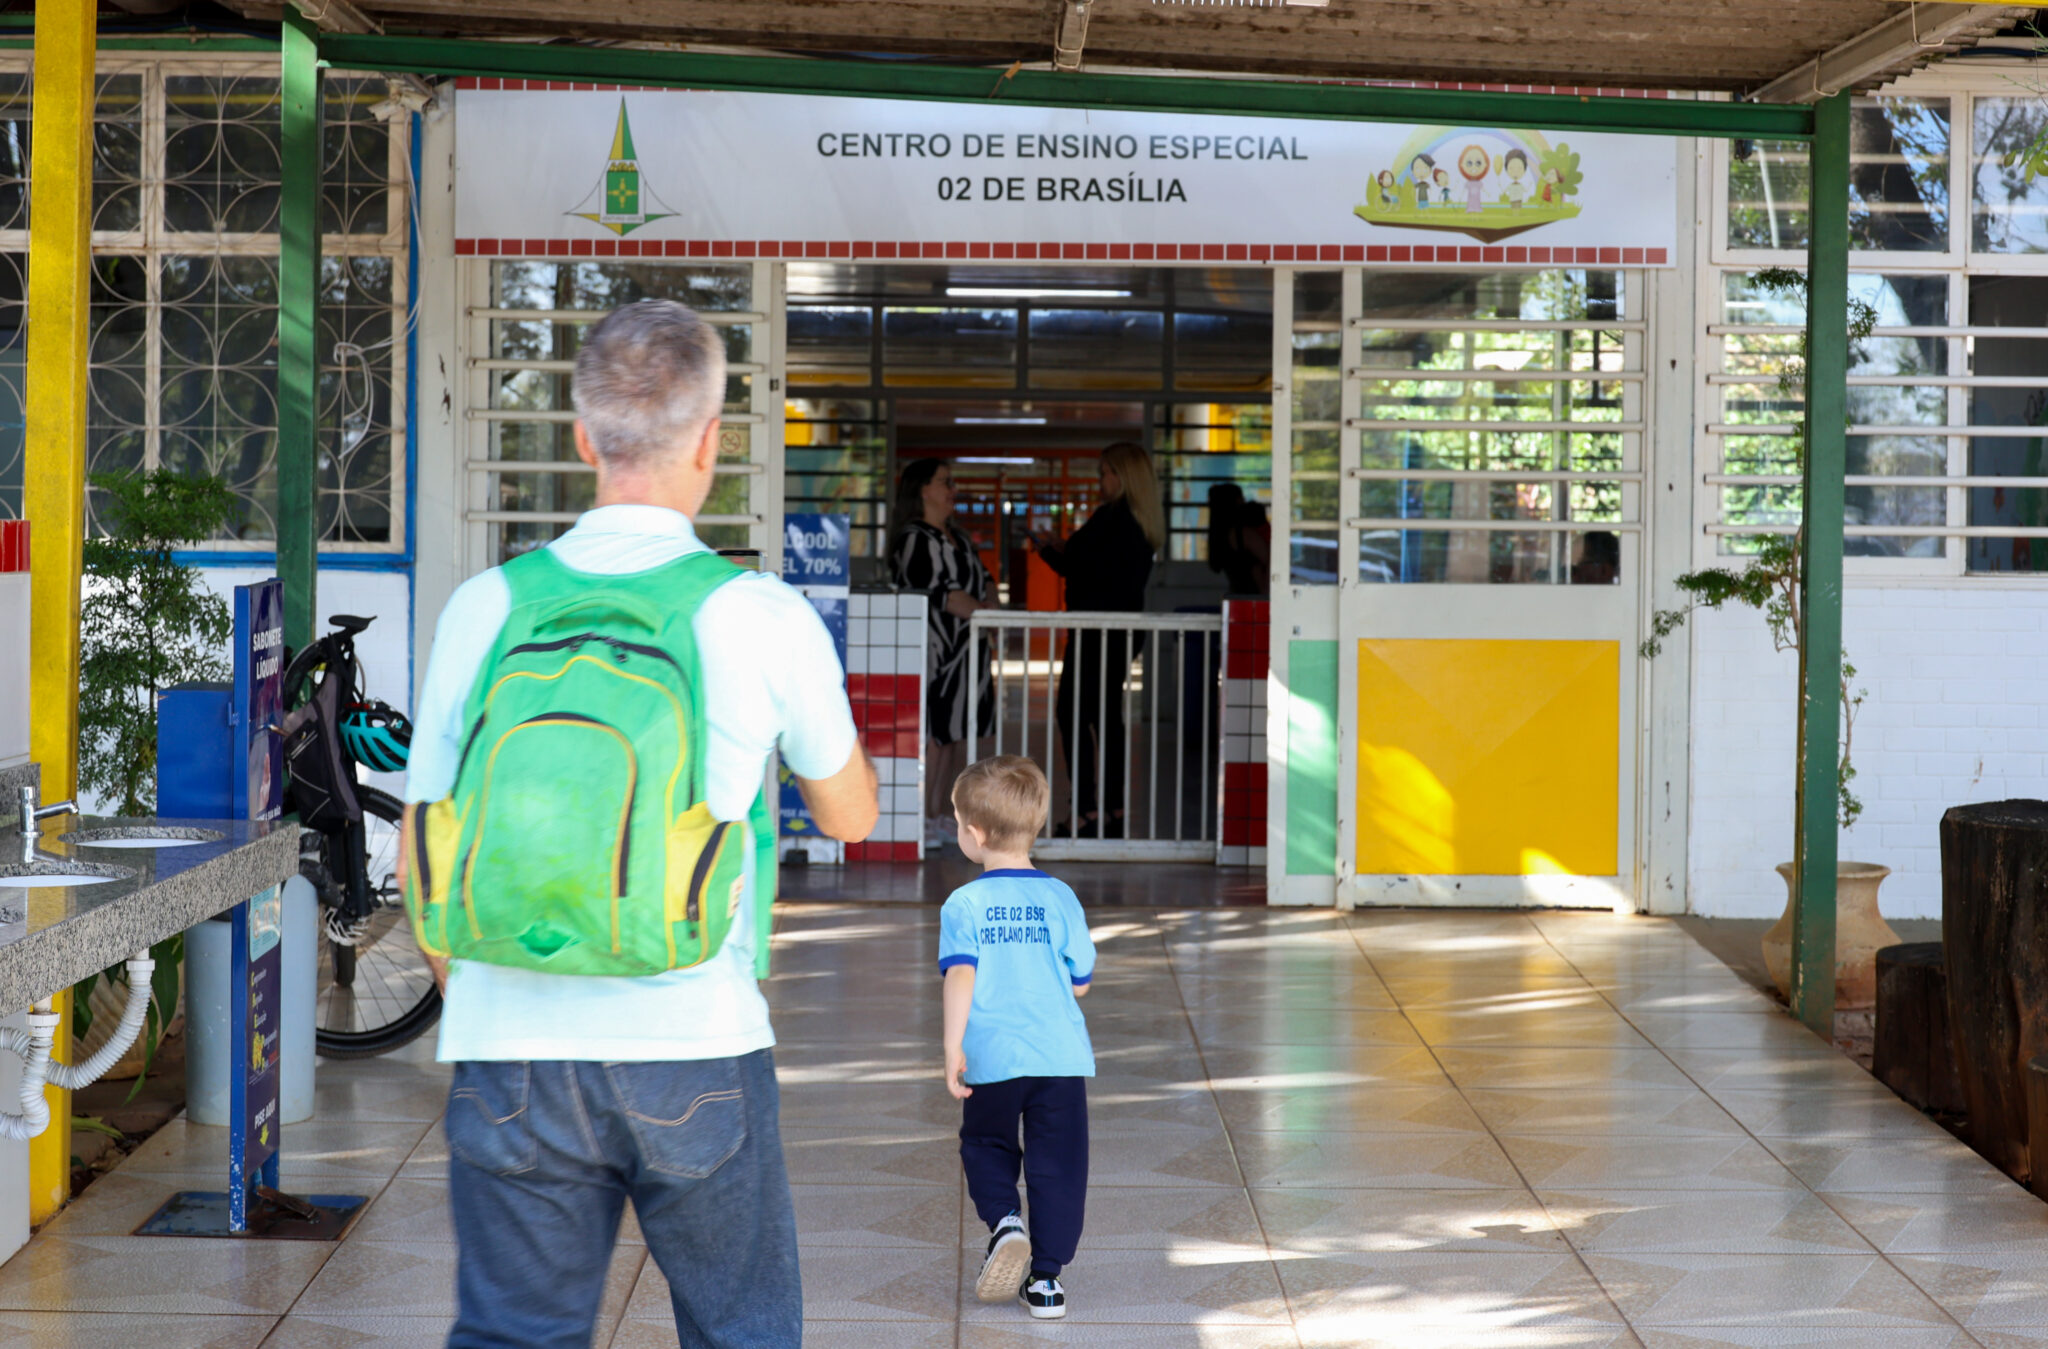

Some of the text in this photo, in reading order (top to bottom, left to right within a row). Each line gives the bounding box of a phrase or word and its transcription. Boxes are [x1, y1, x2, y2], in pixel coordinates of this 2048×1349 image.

[817, 132, 1308, 161] CENTRO DE ENSINO ESPECIAL
[937, 169, 1187, 203] 02 DE BRASÍLIA
[783, 532, 838, 549] LCOOL
[803, 557, 842, 575] 70%
[253, 627, 281, 652] SABONETE
[256, 657, 278, 680] LÍQUIDO
[986, 906, 1045, 922] CEE 02 BSB
[980, 926, 996, 945] CRE
[998, 926, 1023, 944] PLANO
